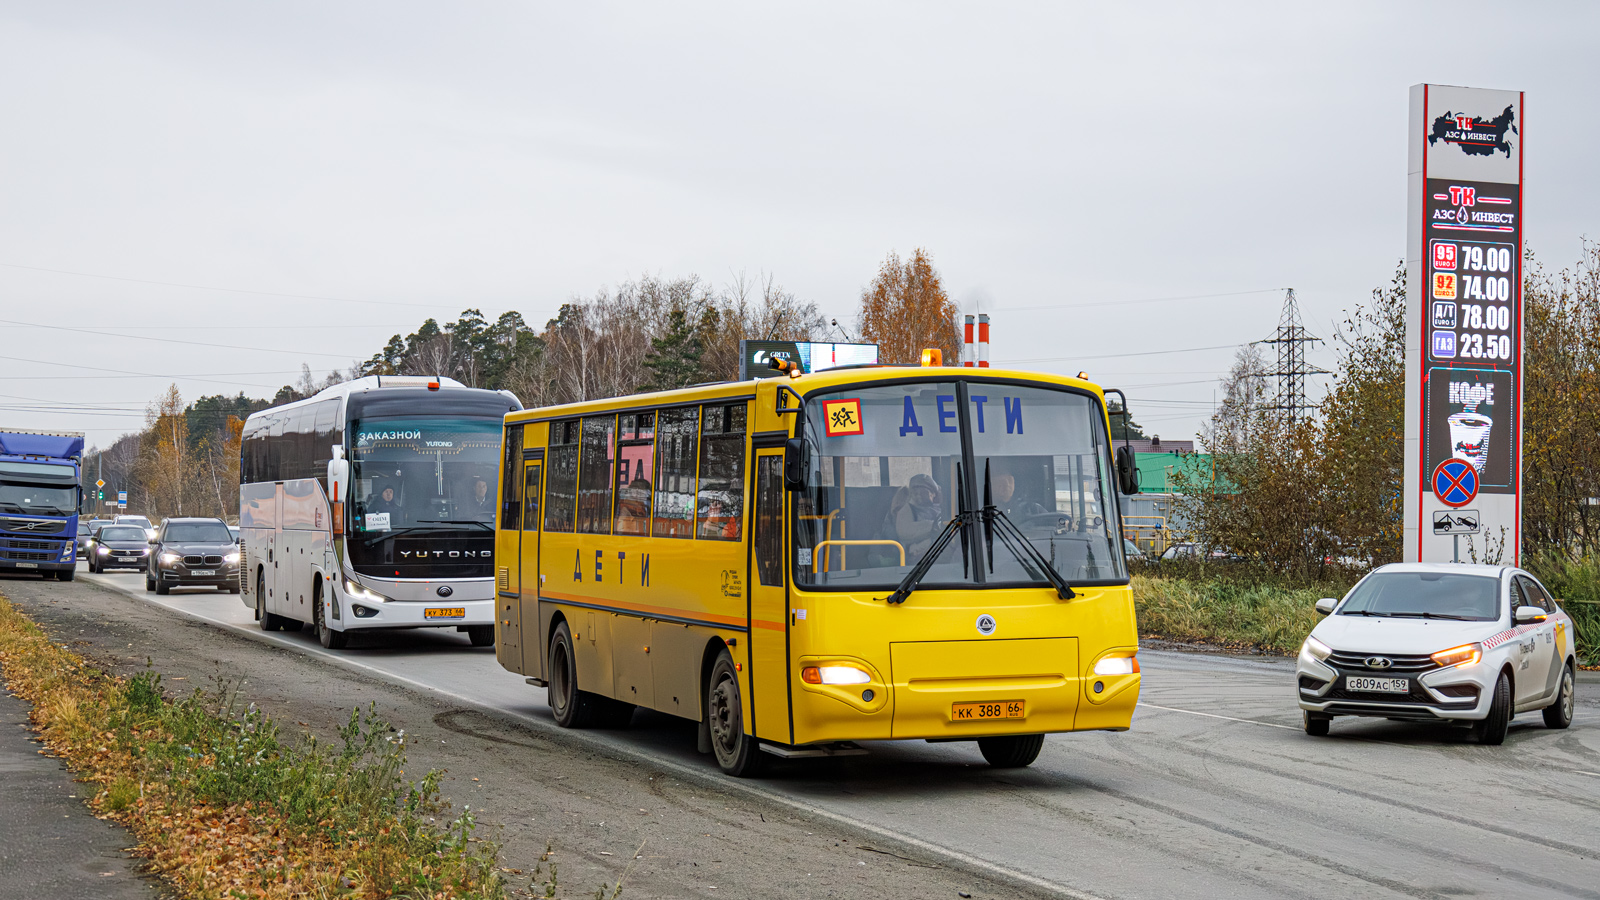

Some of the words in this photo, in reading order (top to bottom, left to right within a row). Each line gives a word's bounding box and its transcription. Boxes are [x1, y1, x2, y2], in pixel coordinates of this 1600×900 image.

[1456, 116, 1473, 130] ТК
[1445, 131, 1460, 139] АЗС
[1467, 133, 1497, 141] ИНВЕСТ
[1449, 186, 1475, 206] ТК
[1433, 209, 1456, 219] АЗС
[1471, 211, 1514, 223] ИНВЕСТ
[1437, 246, 1454, 261] 95
[1461, 246, 1510, 272] 79.00
[1437, 275, 1453, 289] 92
[1462, 275, 1509, 301] 74.00
[1461, 304, 1509, 330] 78.00
[1435, 338, 1453, 351] ГАЗ
[1460, 333, 1510, 360] 23.50
[1449, 381, 1494, 405] КОФЕ
[899, 395, 1024, 437] ДЕТИ
[359, 429, 421, 441] ЗАКАЗНОЙ
[400, 550, 492, 558] YUTONG
[574, 548, 650, 588] ДЕТИ
[1350, 678, 1389, 690] С809АС
[1390, 679, 1406, 689] 159
[958, 708, 973, 718] КК
[978, 704, 1002, 718] 388
[1008, 702, 1020, 713] 66
